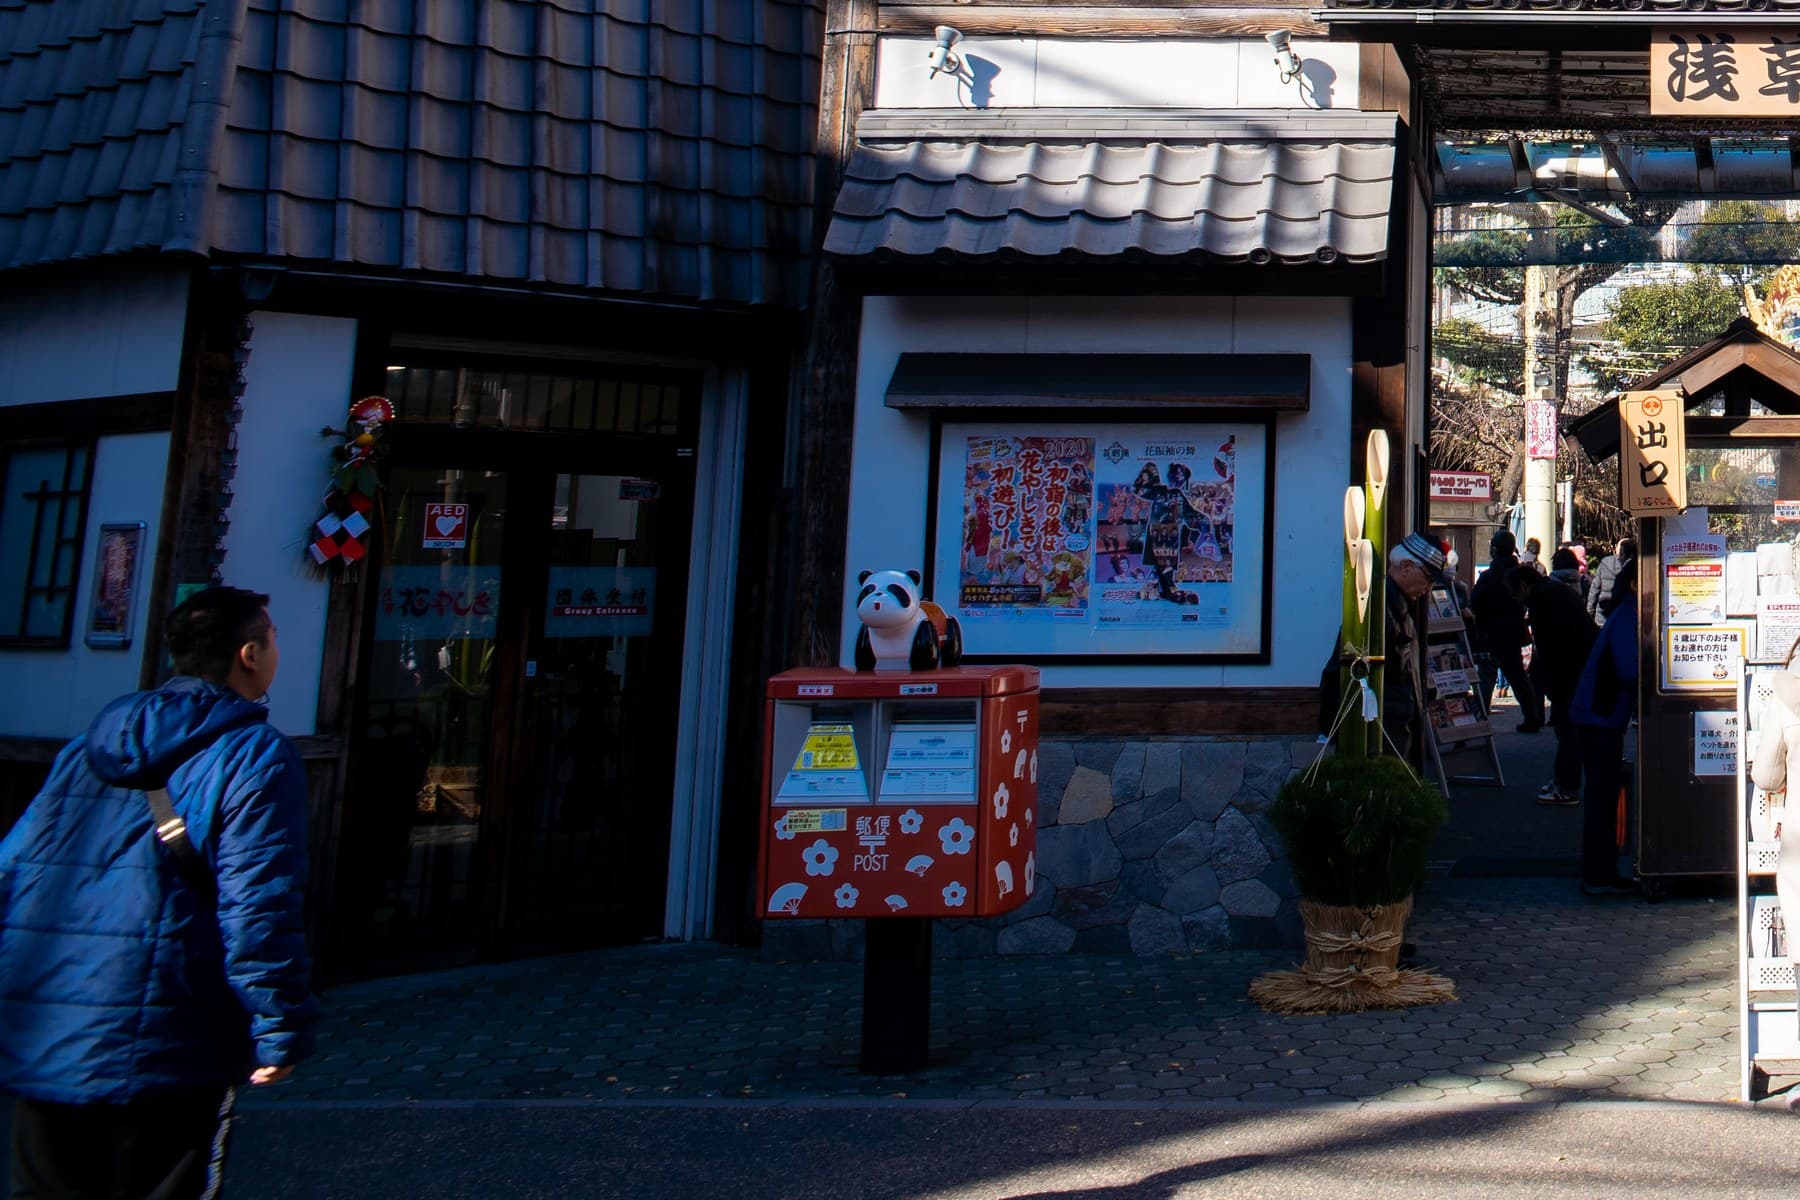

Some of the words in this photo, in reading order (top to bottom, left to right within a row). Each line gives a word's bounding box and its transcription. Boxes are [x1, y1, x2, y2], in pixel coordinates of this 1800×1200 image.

[1043, 439, 1087, 461] 2020
[1145, 445, 1195, 457] 花振袖の舞
[1637, 420, 1669, 487] 出口
[1457, 478, 1488, 488] フリーパス
[1018, 449, 1043, 550] 花やしきで
[1041, 462, 1070, 551] 初詣の後は
[431, 505, 465, 516] AED
[397, 587, 492, 617] 花やしき
[555, 588, 647, 606] 団体受付
[564, 607, 593, 617] Group
[596, 606, 638, 615] Entrance
[1673, 644, 1728, 652] をお連れの方は
[1673, 654, 1728, 662] お知らせ下さい
[1701, 730, 1738, 738] 盲導犬・介
[1700, 741, 1738, 749] ペットを連れ
[856, 815, 891, 836] 郵便
[854, 854, 889, 872] POST
